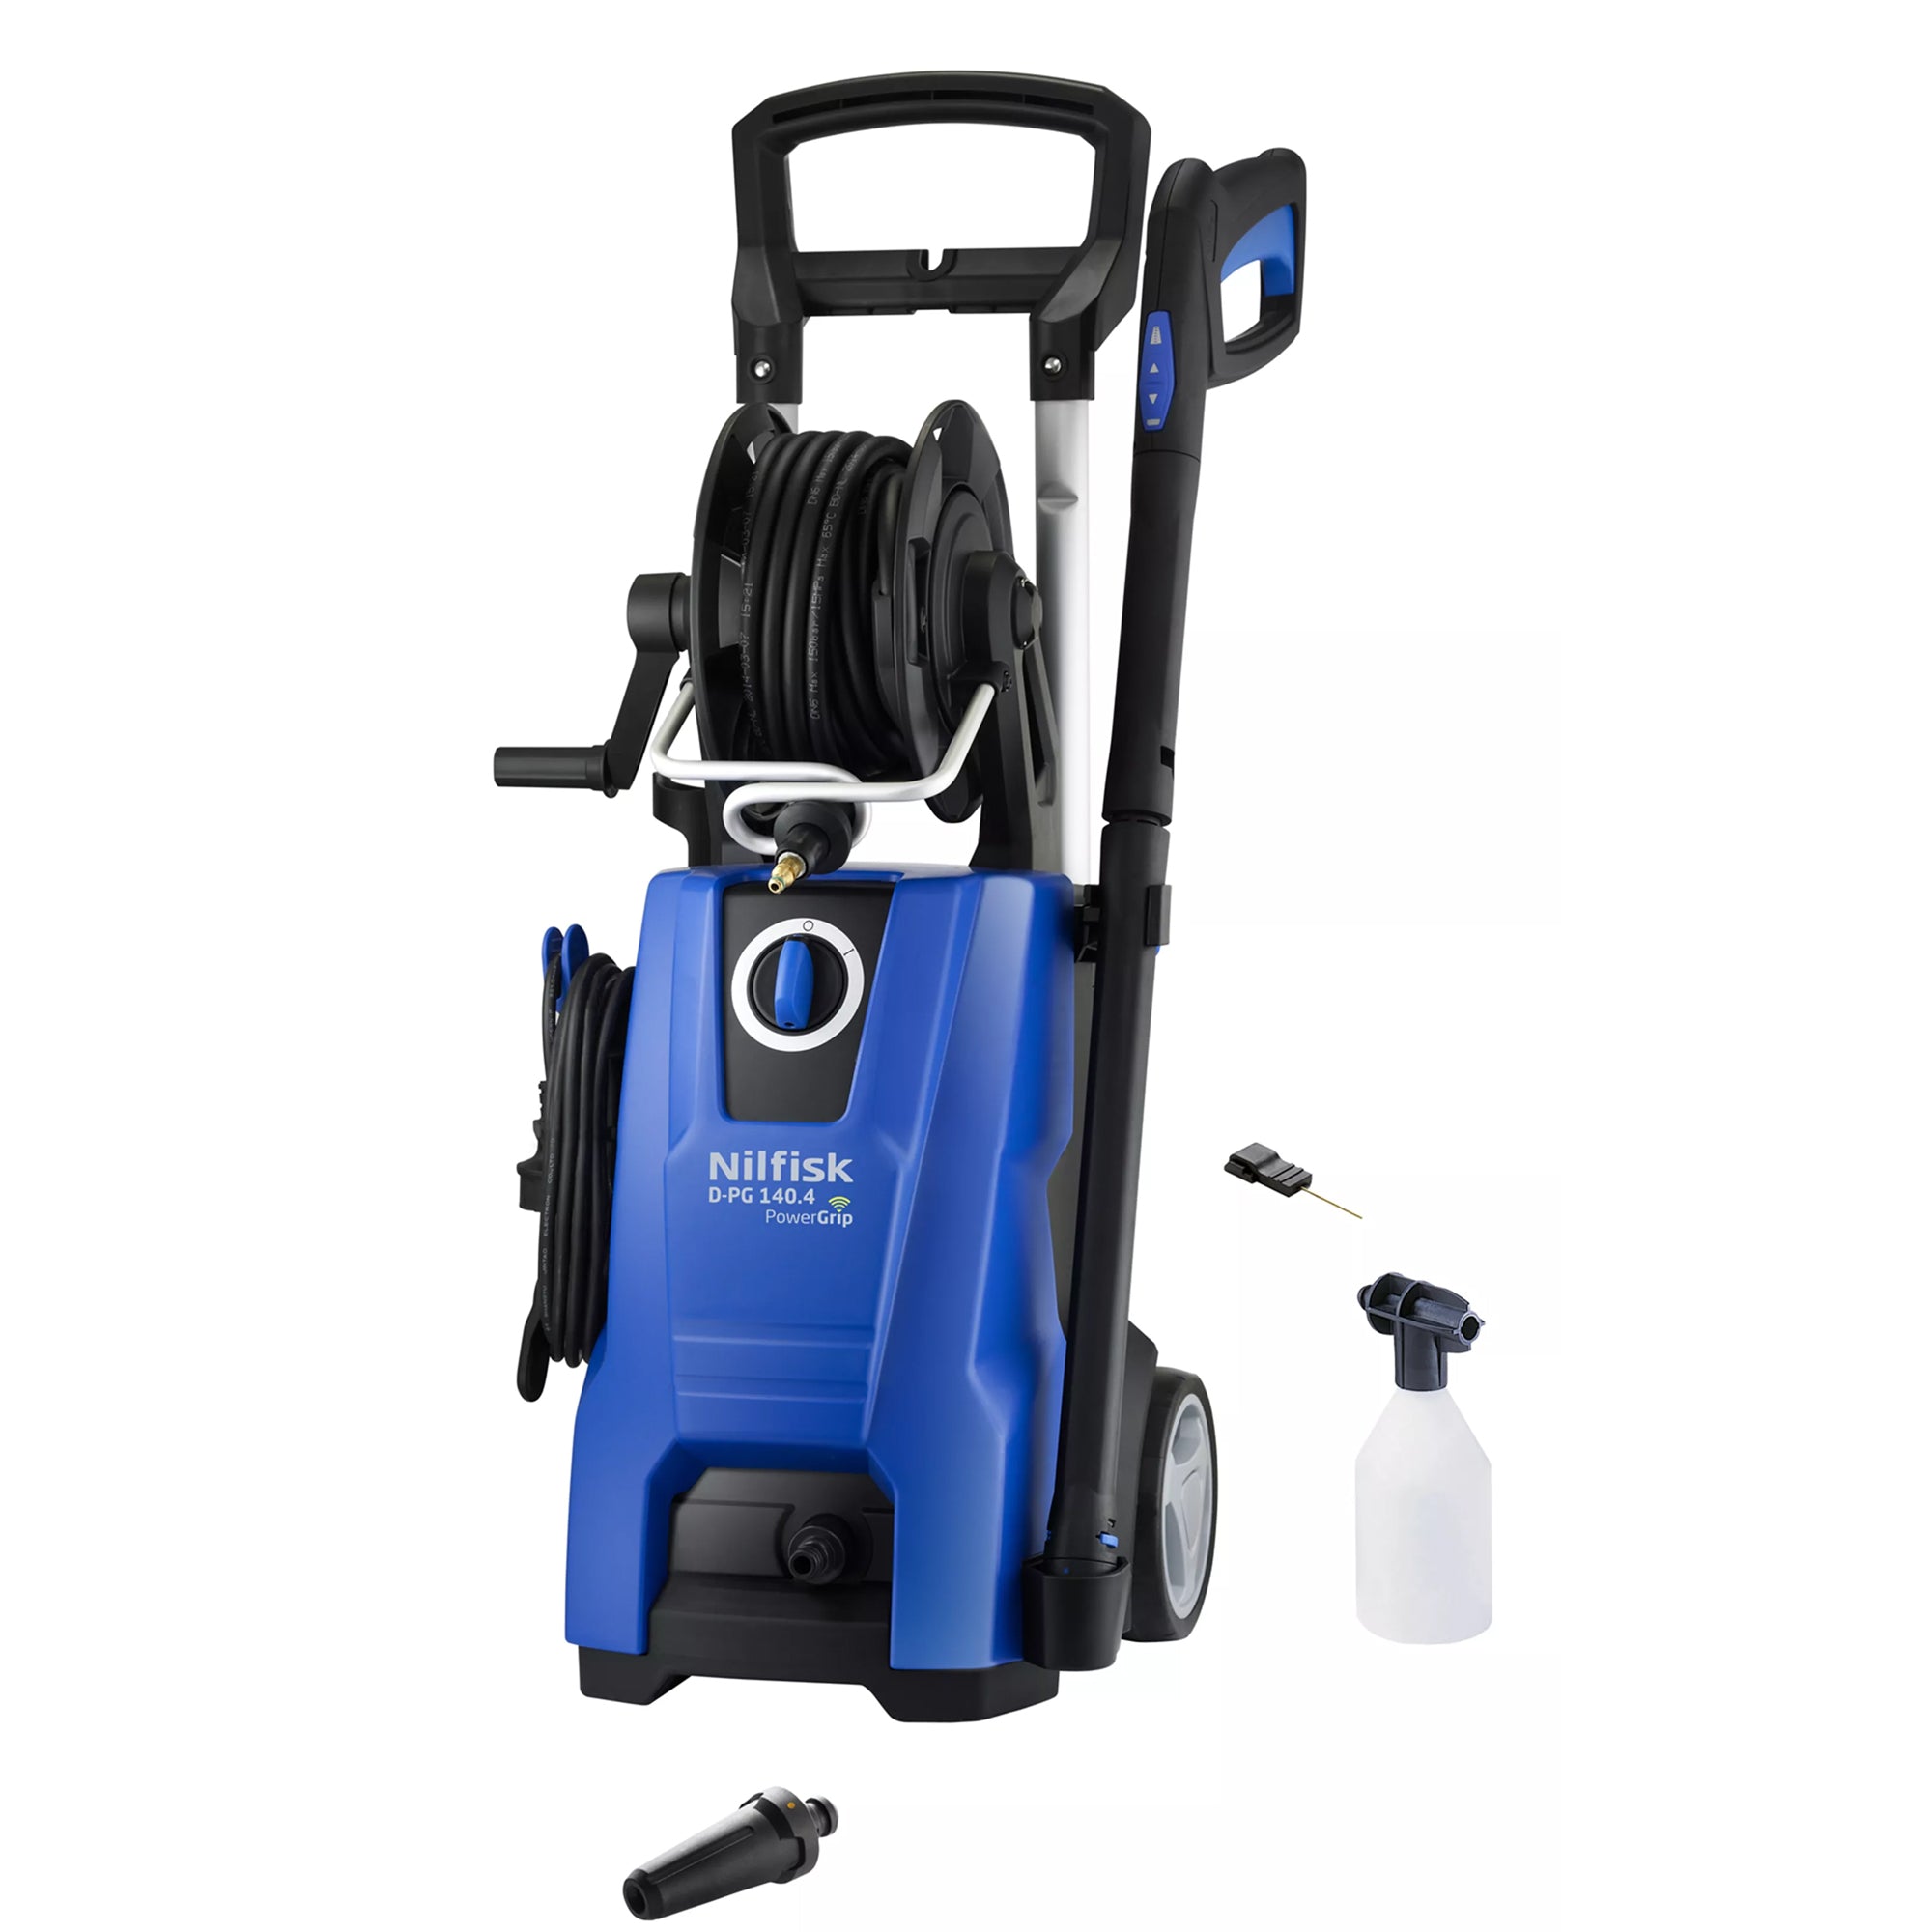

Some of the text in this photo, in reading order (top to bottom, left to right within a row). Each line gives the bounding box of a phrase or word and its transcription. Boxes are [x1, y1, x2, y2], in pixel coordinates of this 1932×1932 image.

[815, 547, 830, 568] Max
[709, 1151, 854, 1182] Nilfisk
[708, 1186, 815, 1205] D-PG 140.4
[765, 1208, 853, 1228] PowerGrip
